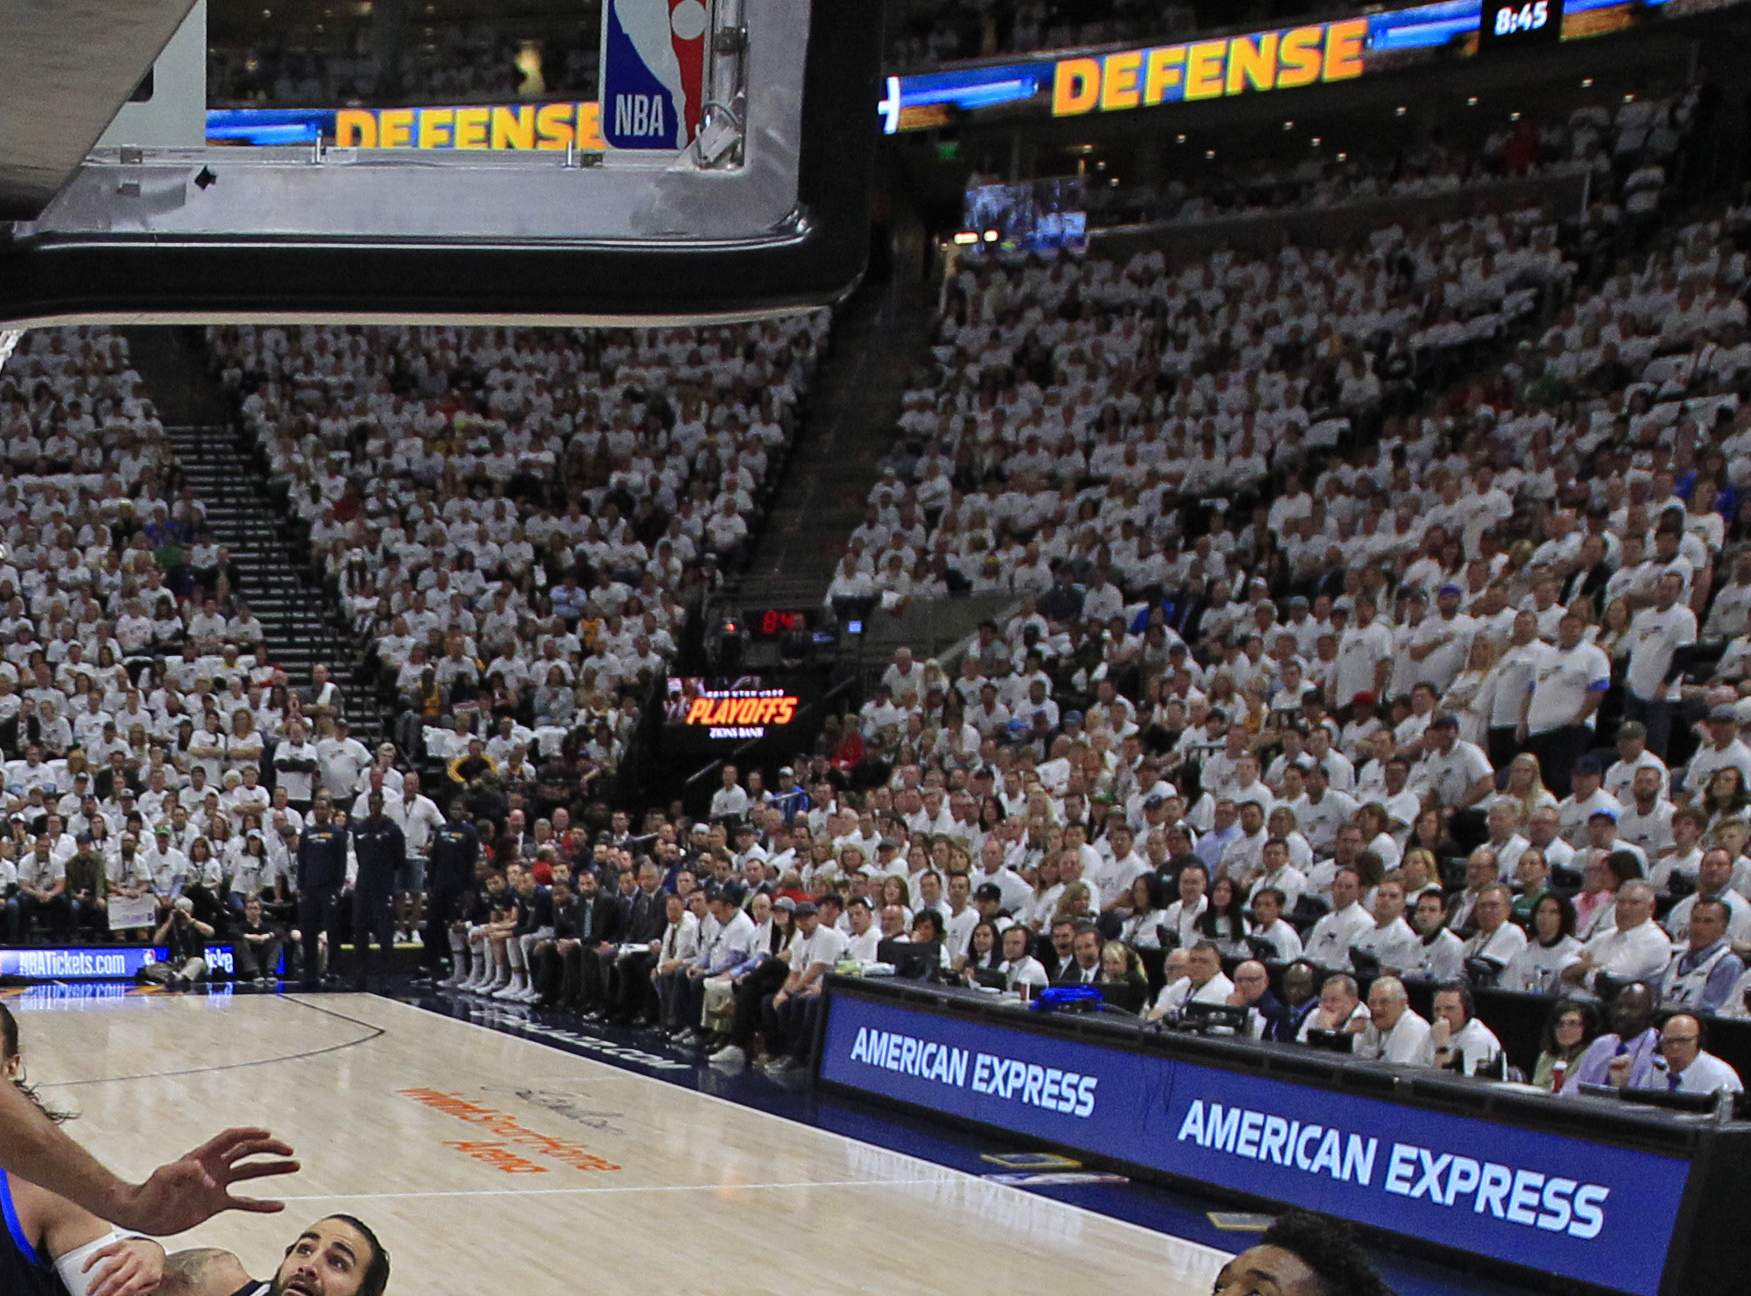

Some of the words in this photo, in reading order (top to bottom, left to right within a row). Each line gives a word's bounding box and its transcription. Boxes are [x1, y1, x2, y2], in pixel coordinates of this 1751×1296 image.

[1494, 0, 1549, 36] 8:45
[1052, 19, 1368, 117] DEFENSE
[615, 93, 664, 137] NBA
[686, 697, 799, 725] PLAYOFFS
[19, 950, 126, 976] NBATickets.com
[850, 1026, 970, 1089] AMERICAN
[972, 1053, 1098, 1118] EXPRESS
[1178, 1099, 1379, 1185] AMERICAN
[1385, 1141, 1610, 1240] EXPRESS
